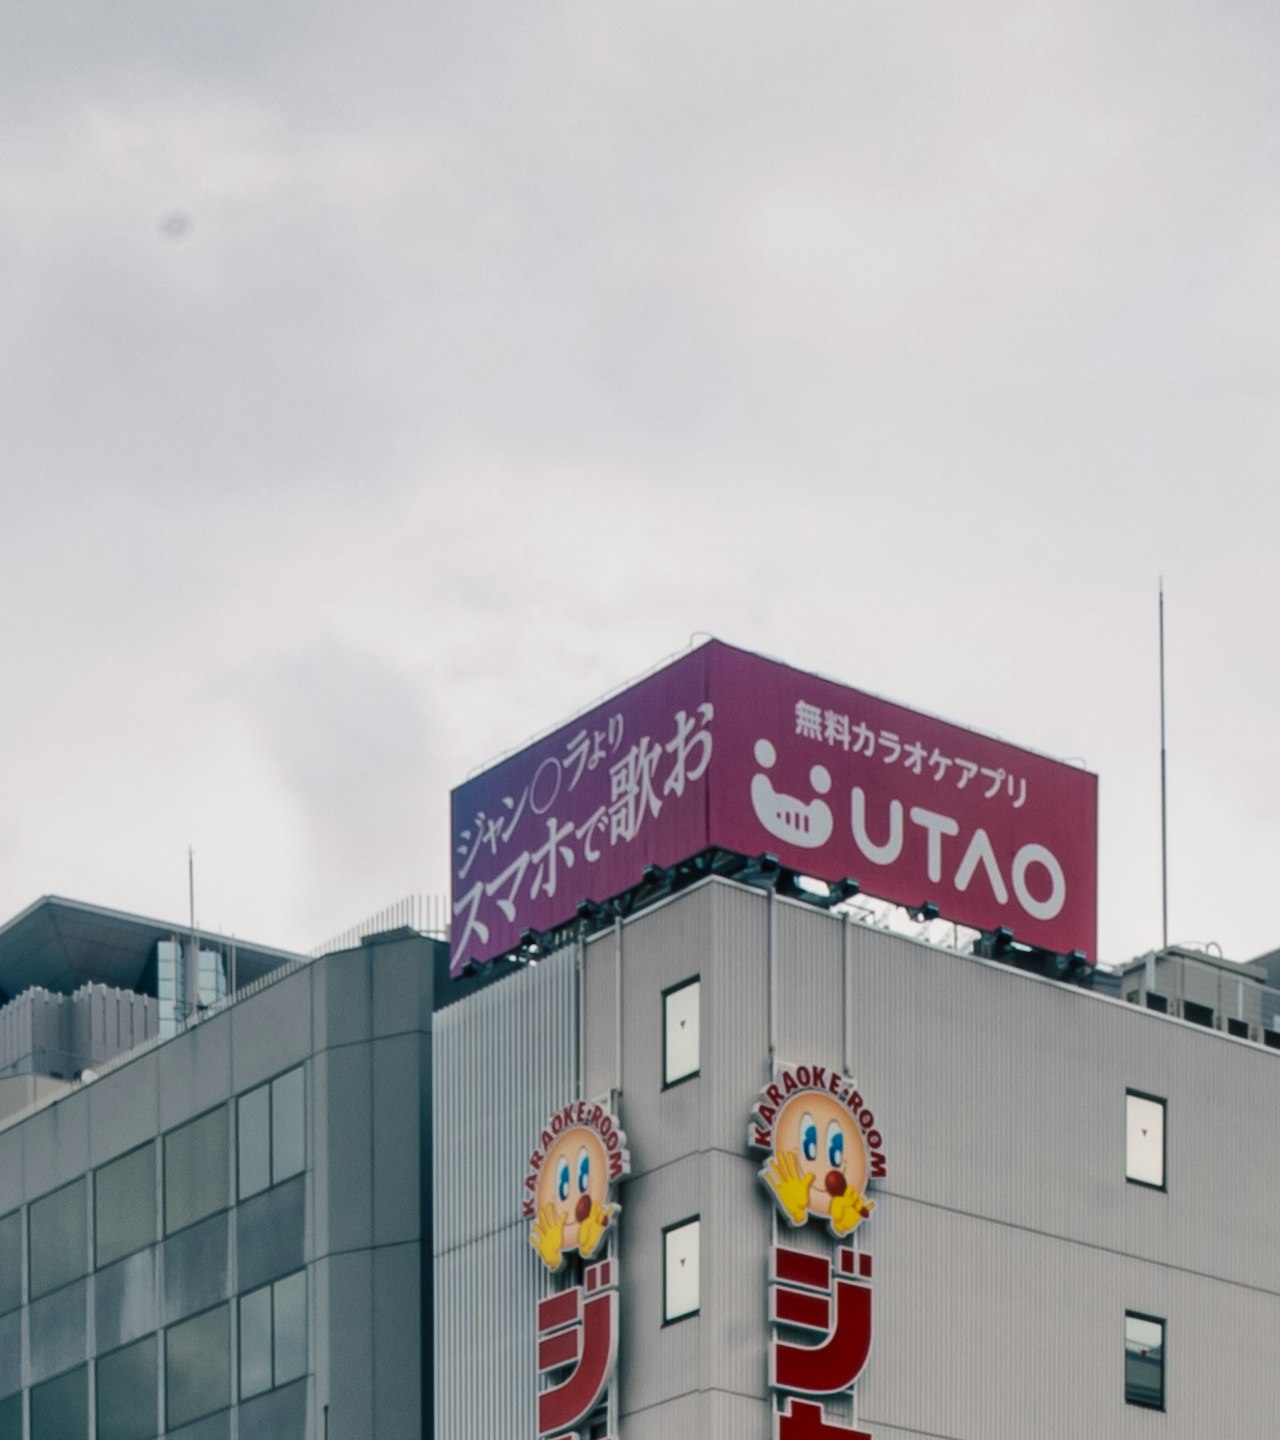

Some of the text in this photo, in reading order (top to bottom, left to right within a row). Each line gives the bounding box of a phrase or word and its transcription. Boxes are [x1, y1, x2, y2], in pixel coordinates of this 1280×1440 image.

[794, 699, 1028, 808] 無料カラオケアプリ
[850, 787, 1066, 921] UTAO
